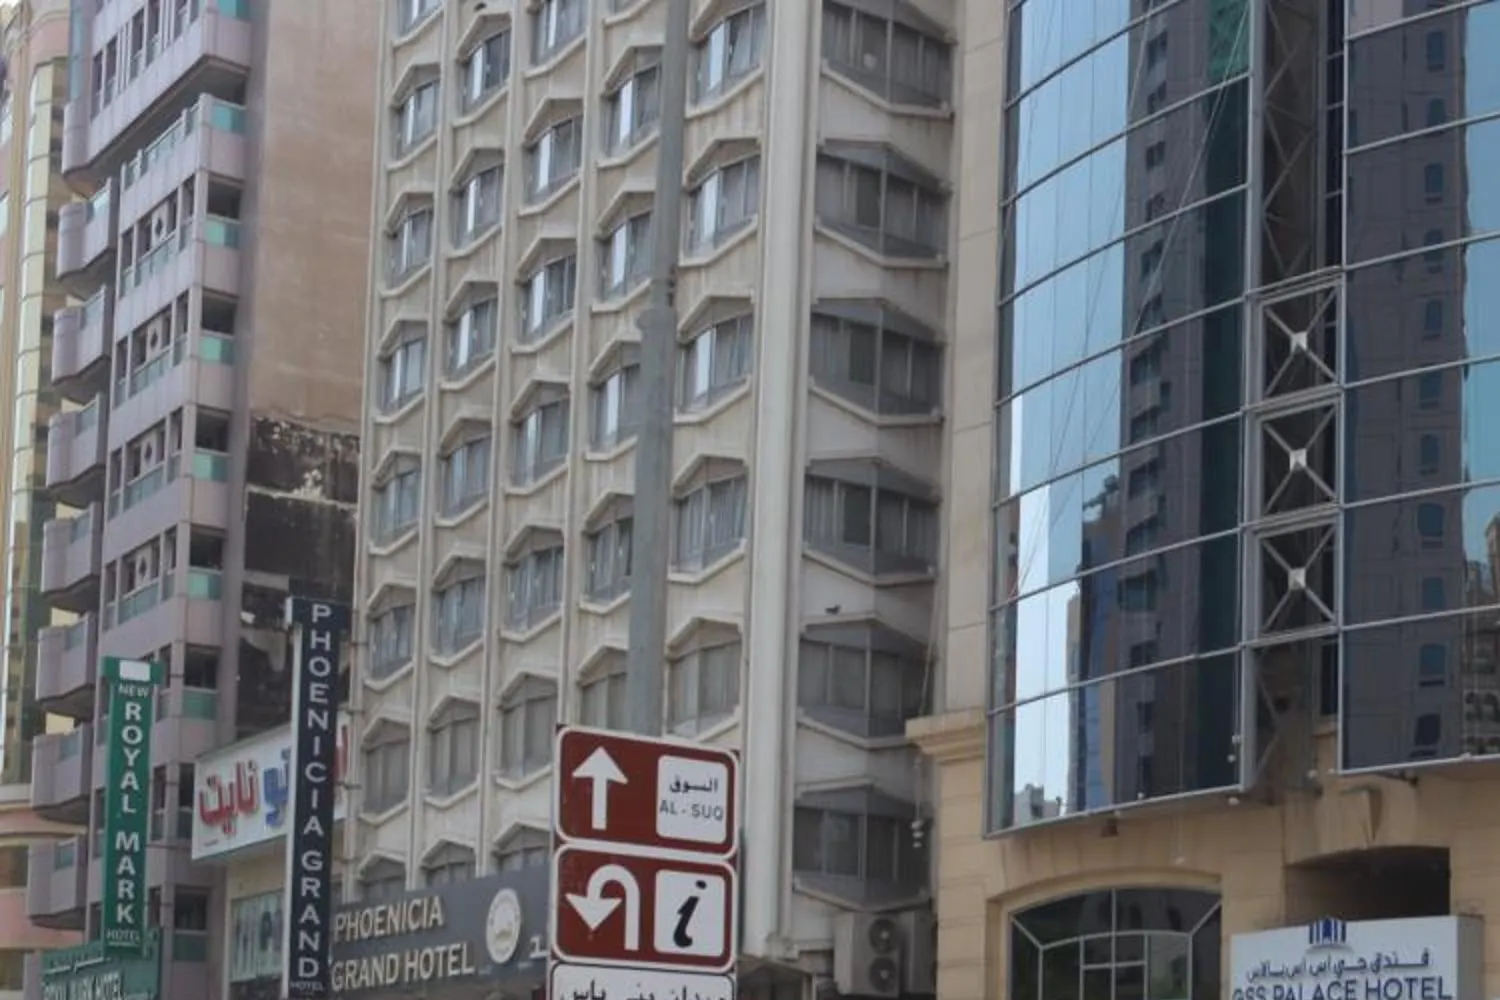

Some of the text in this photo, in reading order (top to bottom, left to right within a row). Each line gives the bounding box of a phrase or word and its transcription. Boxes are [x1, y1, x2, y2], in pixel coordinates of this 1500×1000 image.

[118, 684, 149, 699] NEW
[299, 603, 331, 978] PHOENICIA GRAND
[668, 776, 719, 795] السوق
[115, 701, 144, 925] ROYAL MARK
[106, 928, 141, 942] HOTEL
[334, 894, 444, 943] PHOENICIA
[331, 943, 475, 991] GRAND HOTEL
[1371, 947, 1430, 974] فندق
